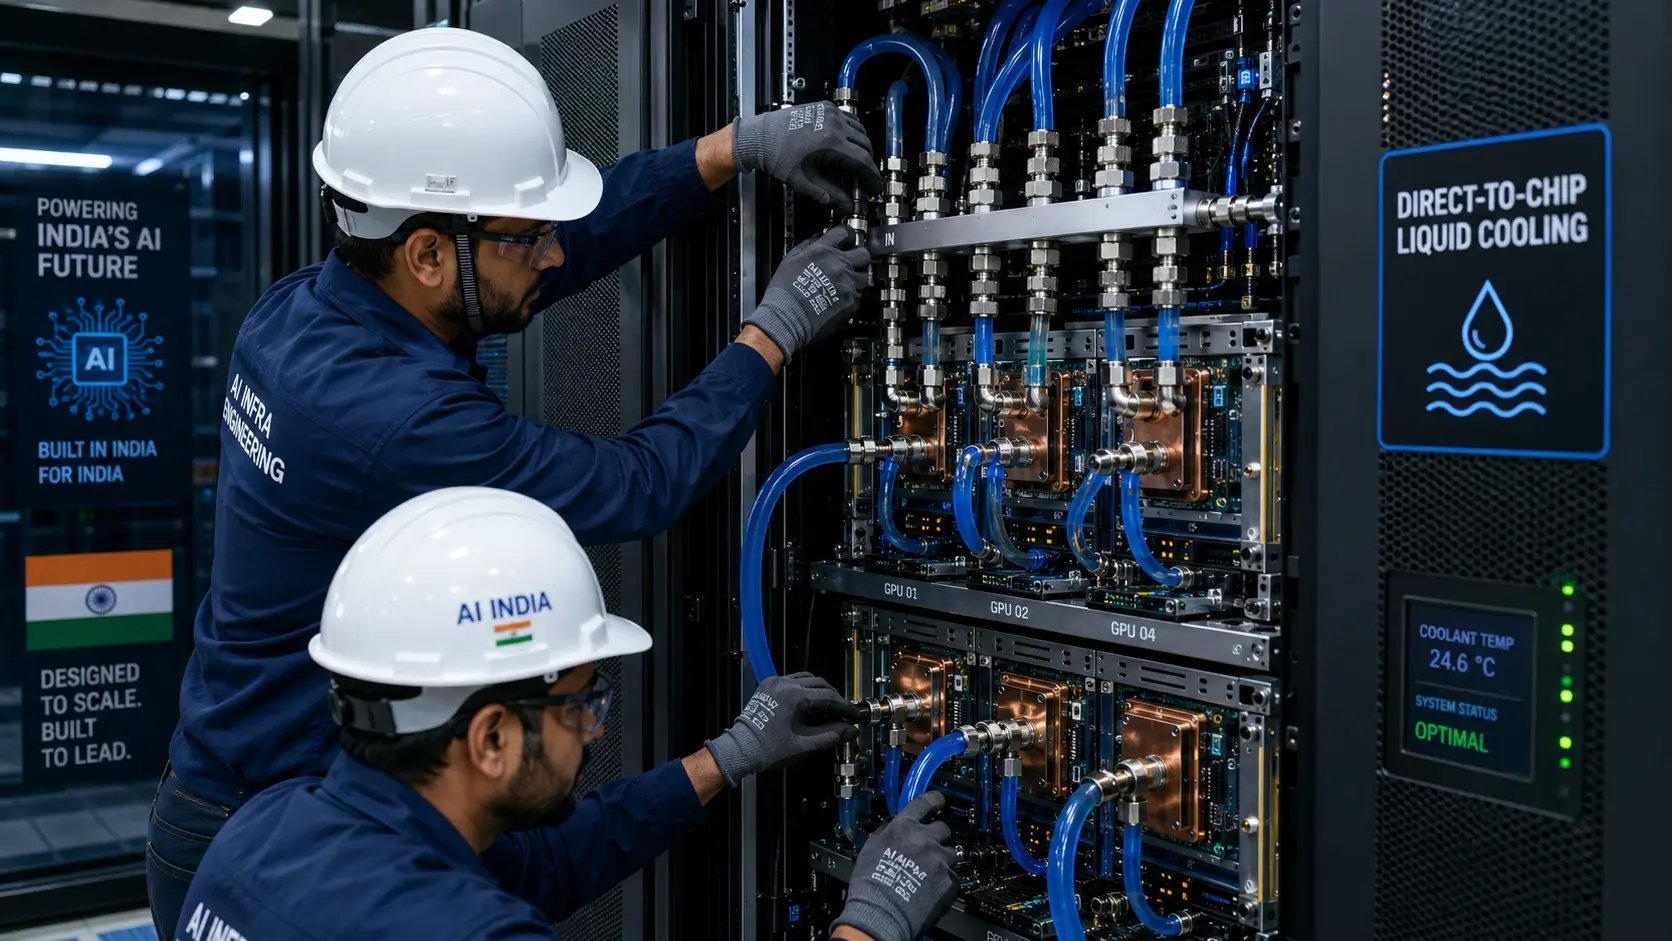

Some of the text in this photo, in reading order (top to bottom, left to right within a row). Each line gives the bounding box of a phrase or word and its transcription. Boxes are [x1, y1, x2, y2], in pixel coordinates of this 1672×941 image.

[37, 198, 138, 220] POWERING
[1397, 174, 1587, 219] DIRECT-TO-CHIP
[37, 222, 161, 251] INDIA'S AI
[885, 232, 895, 247] IN
[1397, 212, 1589, 255] LIQUID COOLING
[37, 253, 138, 279] FUTURE
[85, 347, 115, 371] AI
[230, 373, 273, 440] AI INFRA
[37, 439, 158, 459] BUILT IN INDIA
[222, 397, 285, 484] ENGINEERING
[38, 465, 124, 484] FOR INDIA
[884, 582, 918, 600] GPU 01
[457, 591, 553, 625] AI INDIA
[990, 601, 1029, 620] GPU 02
[1111, 621, 1156, 642] GPU 04
[1419, 624, 1515, 650] COOLANT TEMP
[40, 663, 140, 689] DESIGNED
[1429, 648, 1496, 678] 24.6 °C
[40, 688, 142, 716] TO SCALE.
[1415, 694, 1498, 722] SYSTEM STATUS
[41, 718, 97, 742] BUILT
[1415, 720, 1489, 753] OPTIMAL
[41, 741, 132, 769] TO LEAD.
[185, 902, 211, 941] AI
